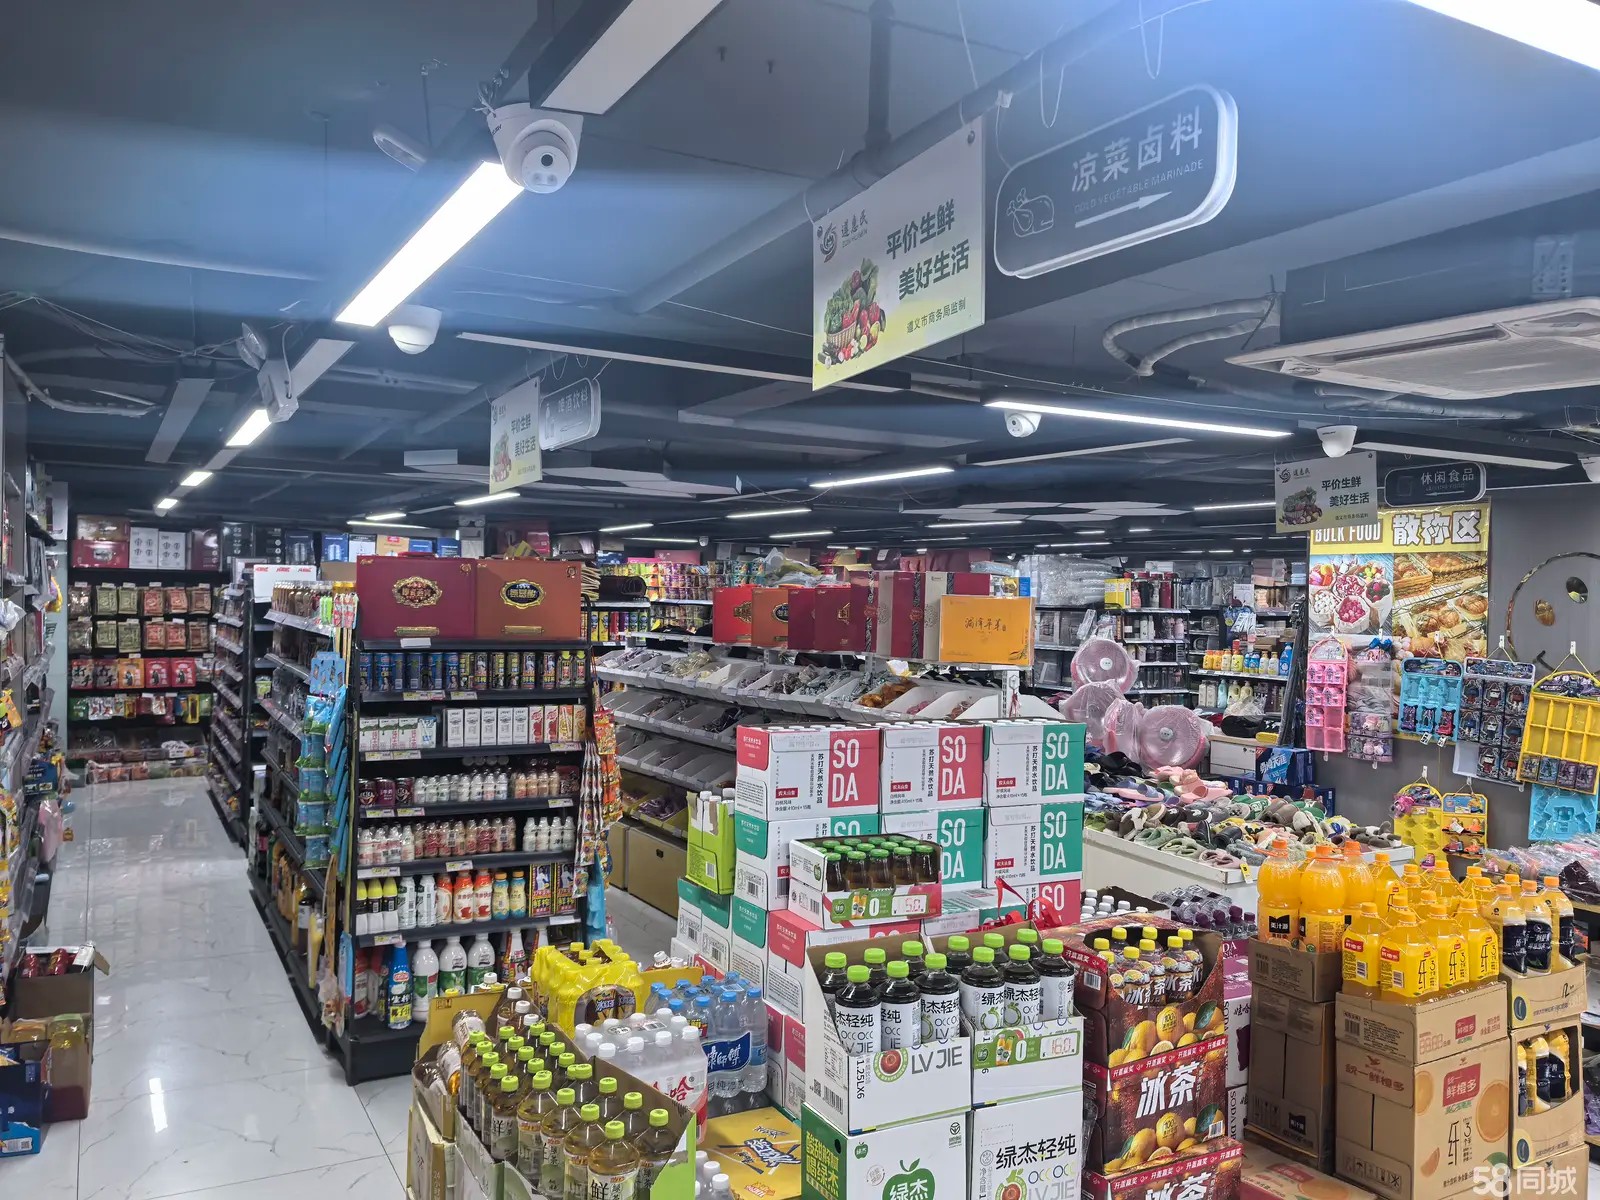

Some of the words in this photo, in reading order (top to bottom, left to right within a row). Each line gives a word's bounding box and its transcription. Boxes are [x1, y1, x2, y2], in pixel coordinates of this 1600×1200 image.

[1072, 104, 1202, 192] 凉菜卤料
[1151, 158, 1204, 187] MARINADE
[886, 198, 955, 260] 平价生鲜
[898, 238, 970, 300] 美好生活
[514, 436, 536, 457] 美好生活
[1321, 475, 1361, 491] 平价生鲜
[1420, 467, 1475, 485] 休闲食品
[1329, 491, 1370, 508] 美好生活
[1392, 509, 1482, 547] 散称区
[832, 738, 860, 769] SO
[941, 735, 967, 764] SO
[1045, 732, 1070, 760] SO
[816, 753, 825, 804] 苏打天然水饮品
[927, 748, 935, 798] 苏打天然水饮品
[941, 766, 966, 796] DA
[1031, 745, 1039, 793] 苏打天然水饮品
[1045, 763, 1069, 791] DA
[831, 772, 859, 803] DA
[939, 817, 967, 848] SO
[1043, 810, 1067, 839] SO
[1029, 825, 1037, 872] 苏打天然水饮品
[1042, 842, 1067, 870] DA
[941, 850, 966, 880] DA
[911, 1051, 934, 1075] LV
[935, 1045, 963, 1069] JIE
[856, 1060, 865, 1099] 1.25LX6
[1135, 1060, 1200, 1119] 冰茶
[1345, 1063, 1405, 1092] 统一鲜橙多
[1446, 1078, 1477, 1099] 鲜橙多
[1463, 1122, 1472, 1138] 3
[995, 1133, 1077, 1170] 绿杰轻纯
